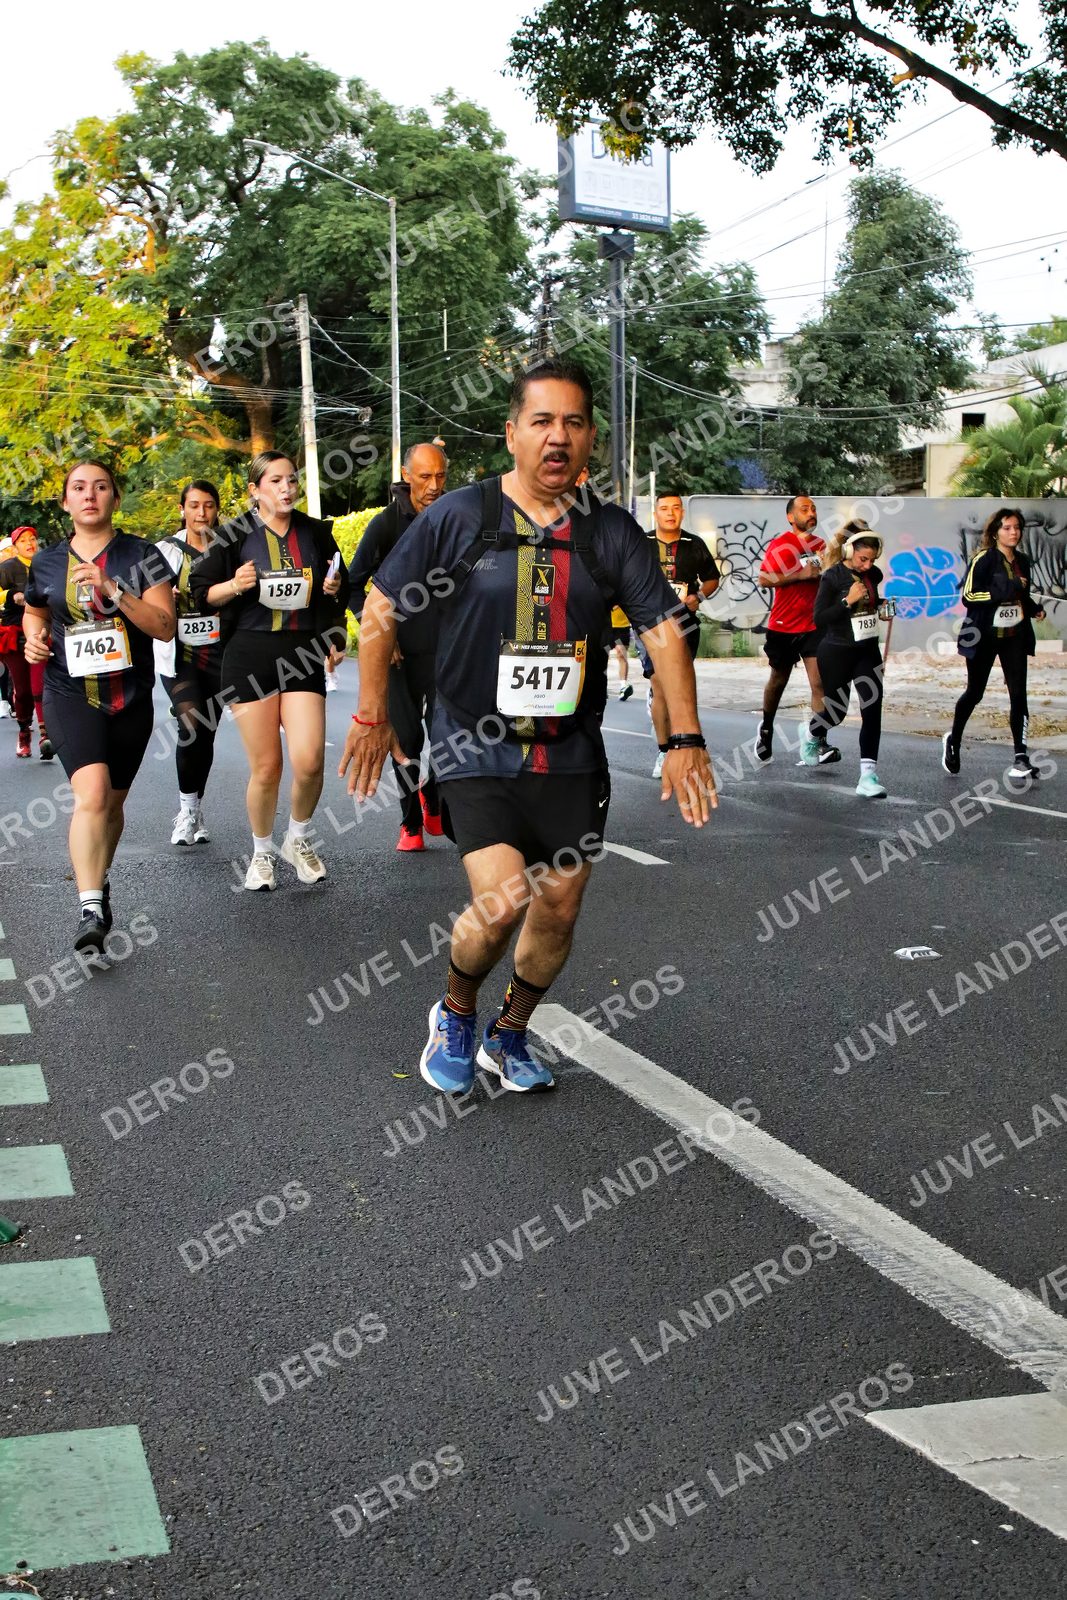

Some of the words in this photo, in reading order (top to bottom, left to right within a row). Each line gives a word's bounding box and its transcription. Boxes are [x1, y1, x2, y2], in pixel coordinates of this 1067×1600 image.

[717, 520, 768, 540] TOY
[267, 582, 302, 598] 1587
[999, 608, 1018, 618] 6651
[183, 620, 214, 635] 2823
[858, 617, 877, 630] 7839
[73, 636, 117, 658] 7462
[510, 666, 571, 690] 5417
